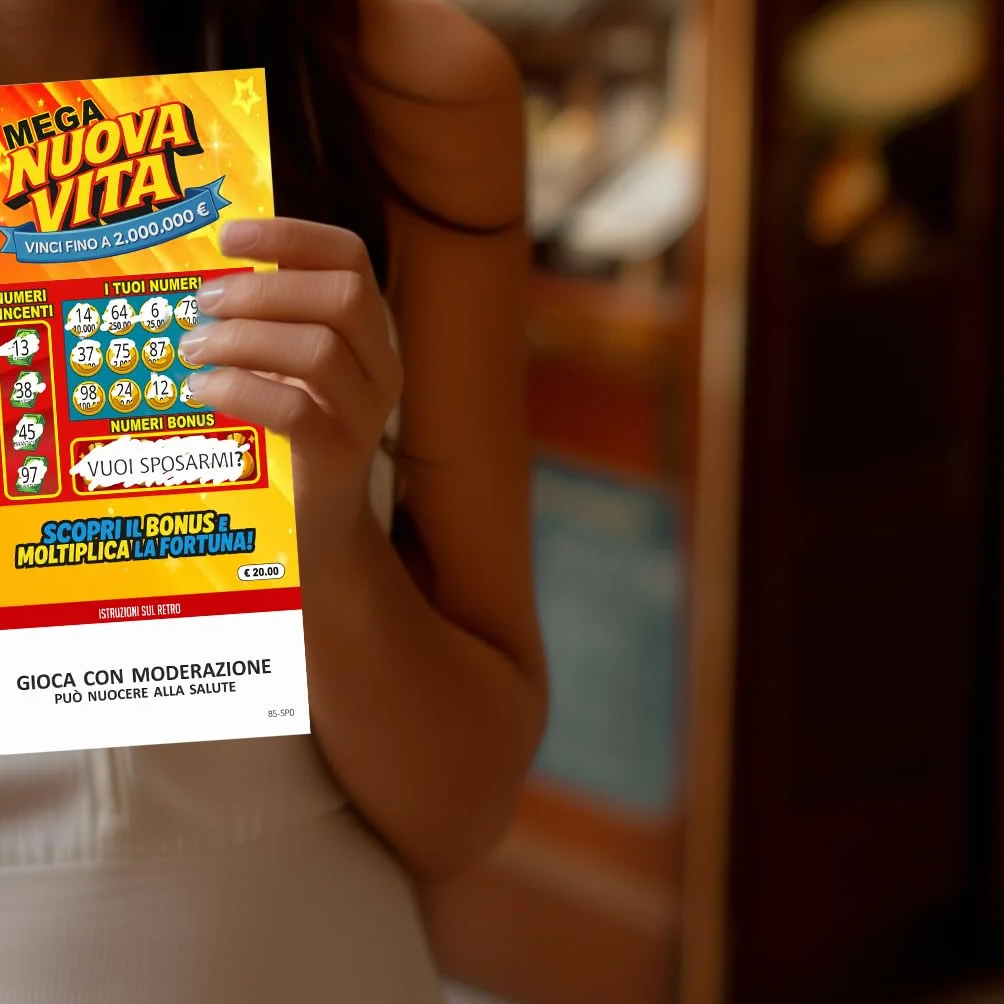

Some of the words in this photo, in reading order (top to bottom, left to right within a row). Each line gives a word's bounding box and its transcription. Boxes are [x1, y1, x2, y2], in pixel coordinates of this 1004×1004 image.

[2, 97, 105, 150] MEGA
[4, 101, 200, 204] NUOVA
[28, 152, 183, 232] VITA
[24, 234, 62, 254] VINCI
[65, 238, 98, 252] FINO
[101, 236, 111, 248] A
[114, 211, 194, 247] 2.000.000
[197, 201, 210, 217] €
[104, 282, 108, 296] I
[111, 280, 146, 295] TUOI
[149, 276, 203, 293] NUMERI
[76, 307, 92, 323] 14
[111, 304, 128, 319] 64
[151, 302, 159, 317] 6
[182, 300, 198, 316] 79
[13, 340, 29, 356] 13
[77, 346, 94, 362] 37
[114, 343, 130, 359] 75
[149, 341, 165, 357] 87
[15, 381, 32, 399] 38
[80, 385, 97, 400] 98
[116, 382, 132, 397] 24
[152, 380, 169, 396] 12
[18, 424, 36, 440] 45
[110, 416, 162, 433] NUMERI
[168, 413, 215, 429] BONUS
[21, 466, 38, 483] 97
[87, 458, 133, 477] VUOI
[140, 451, 244, 474] SPOSARMI?
[42, 518, 121, 545] SCOPRI
[125, 518, 142, 538] IL
[146, 512, 215, 538] BONUS
[218, 516, 229, 533] E
[17, 539, 130, 567] MOLTIPLICA
[134, 539, 156, 558] LA
[159, 530, 254, 557] FORTUNA!
[243, 568, 251, 577] €
[252, 566, 279, 577] 20.00
[98, 605, 140, 620] ISTRUZIONI
[141, 604, 156, 616] SUL
[157, 603, 181, 616] RETRO
[16, 672, 76, 691] GIOCA
[83, 668, 124, 687] CON
[132, 658, 272, 684] MODERAZIONE
[54, 687, 83, 705] PUÒ
[87, 686, 149, 702] NUOCERE
[153, 684, 185, 698] ALLA
[189, 681, 237, 696] SALUTE
